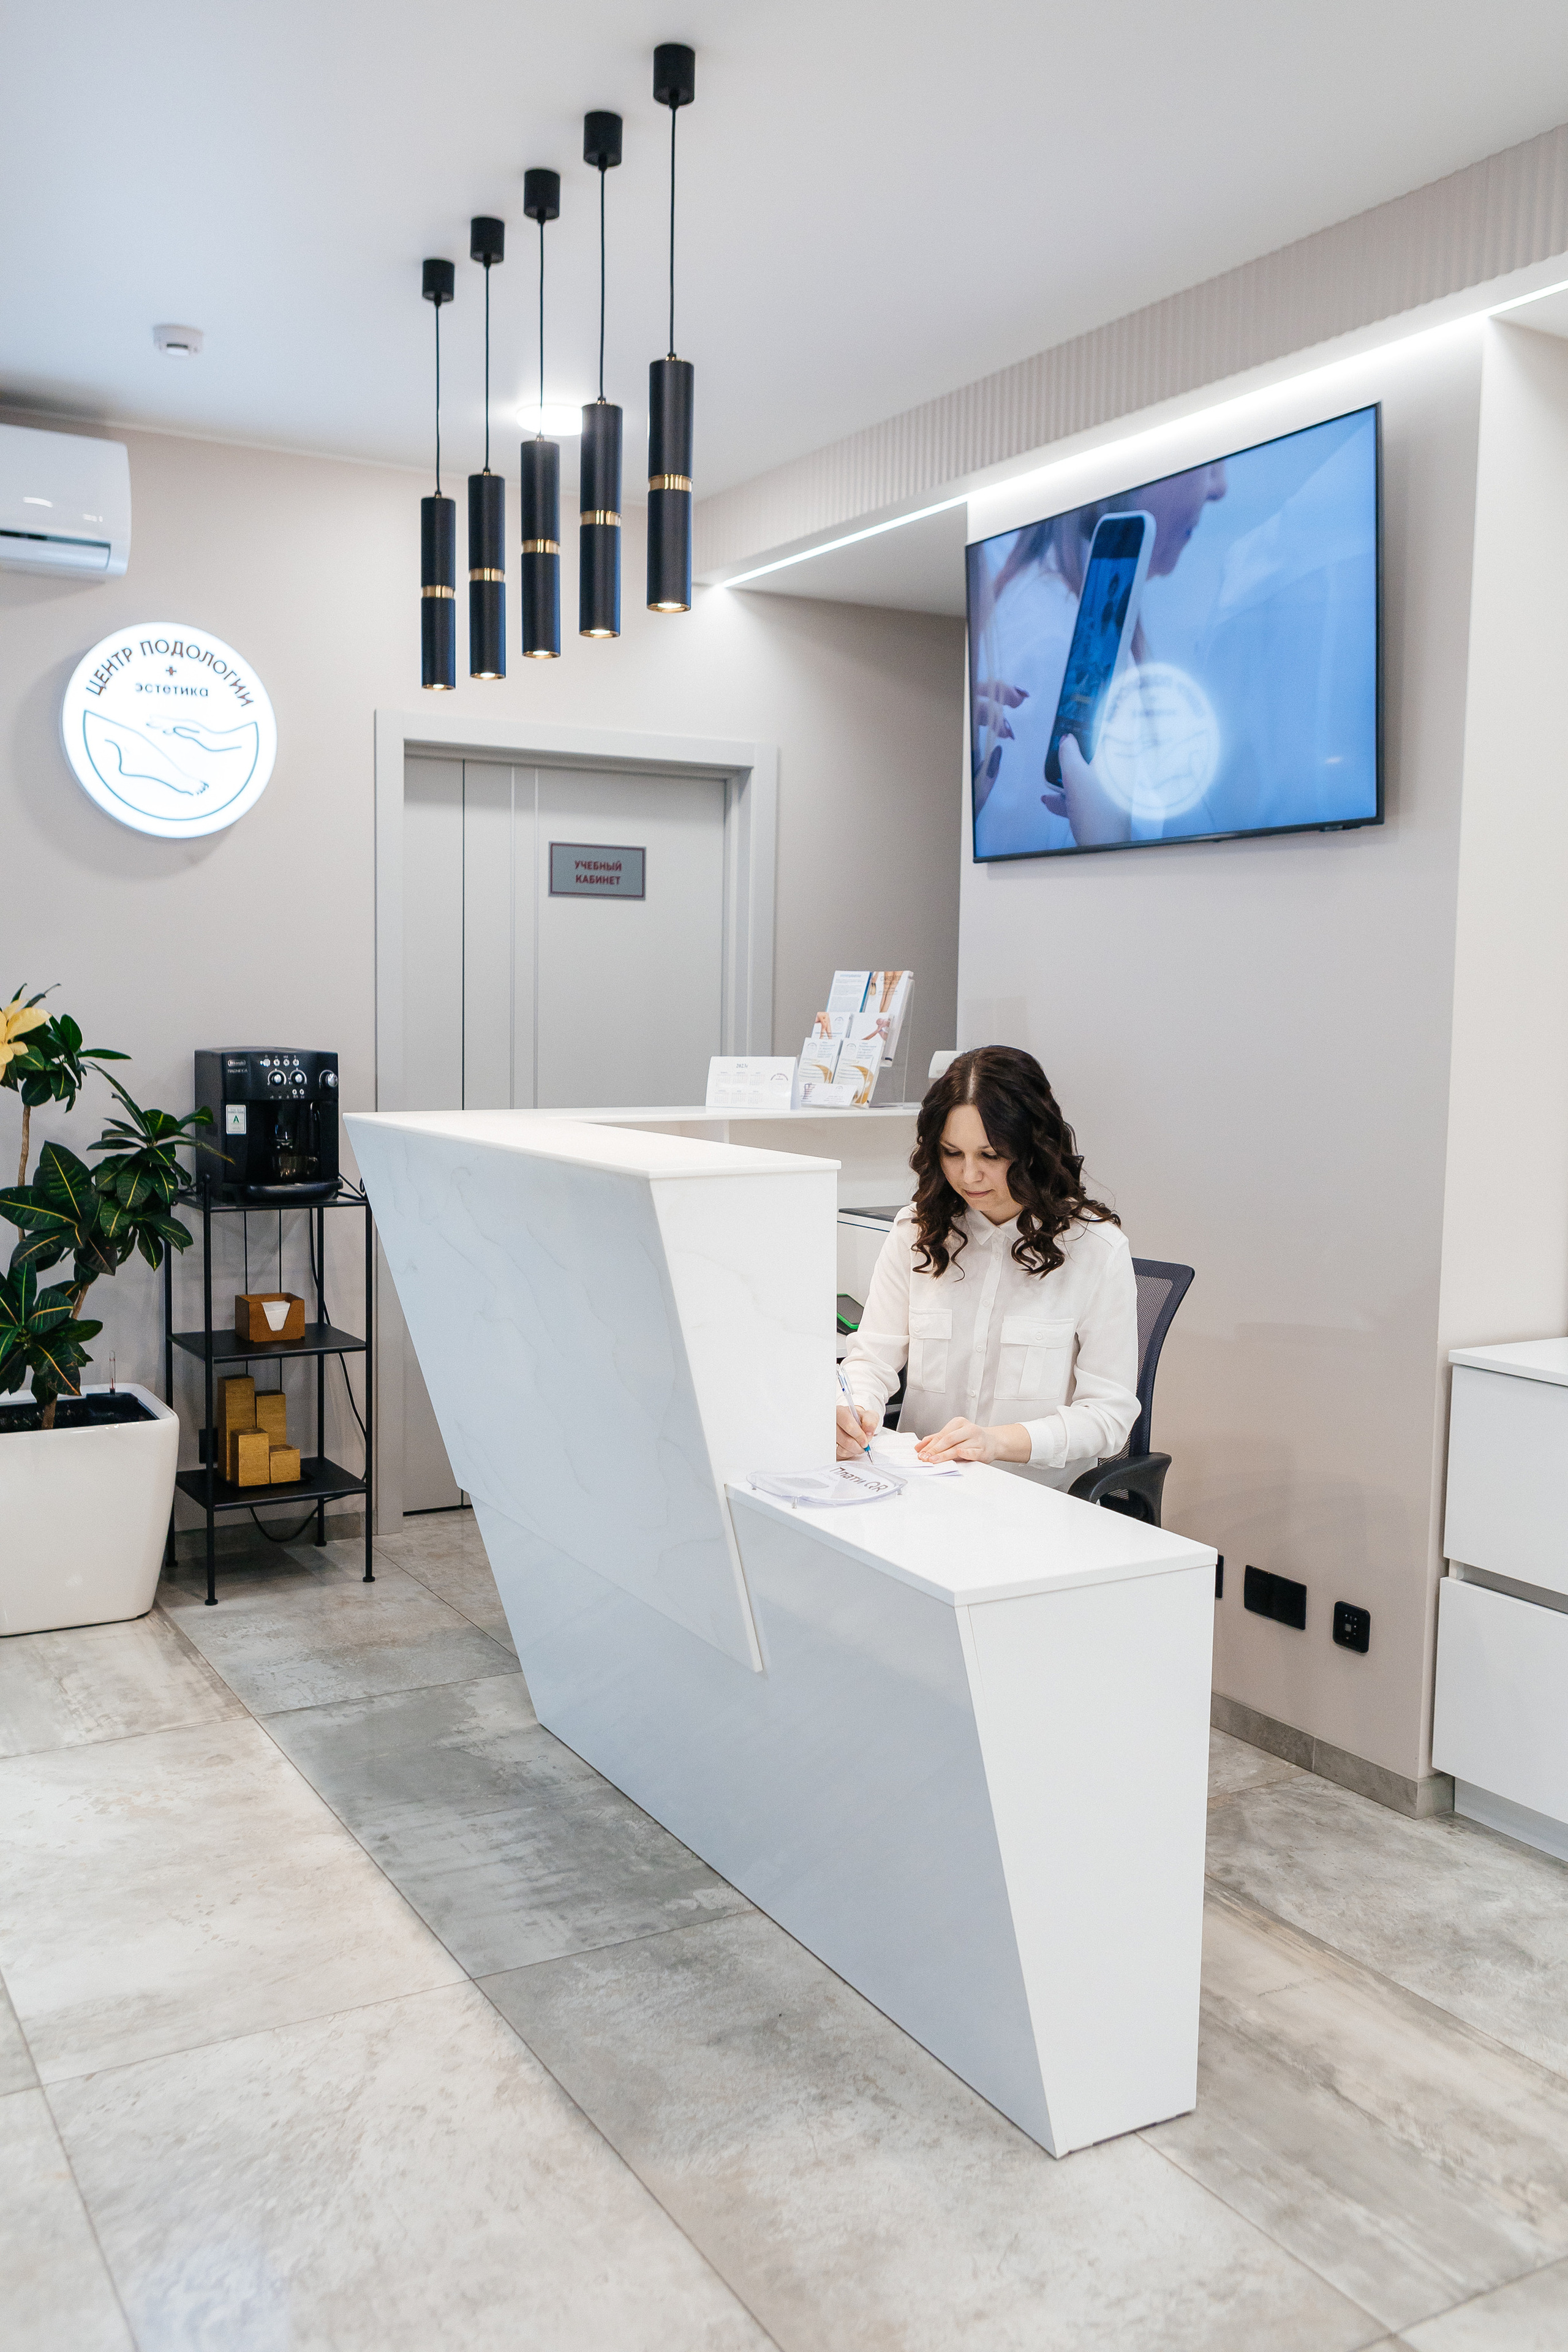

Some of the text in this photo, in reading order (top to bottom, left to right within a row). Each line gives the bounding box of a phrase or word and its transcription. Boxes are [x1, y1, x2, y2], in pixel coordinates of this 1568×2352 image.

[86, 639, 254, 707] ЦЕНТР ПОДОЛОГИИ
[135, 682, 209, 697] эстетика
[575, 860, 622, 872] УЧЕБНЫЙ
[575, 874, 621, 885] КАБИНЕТ
[830, 1467, 889, 1492] Плати QR
